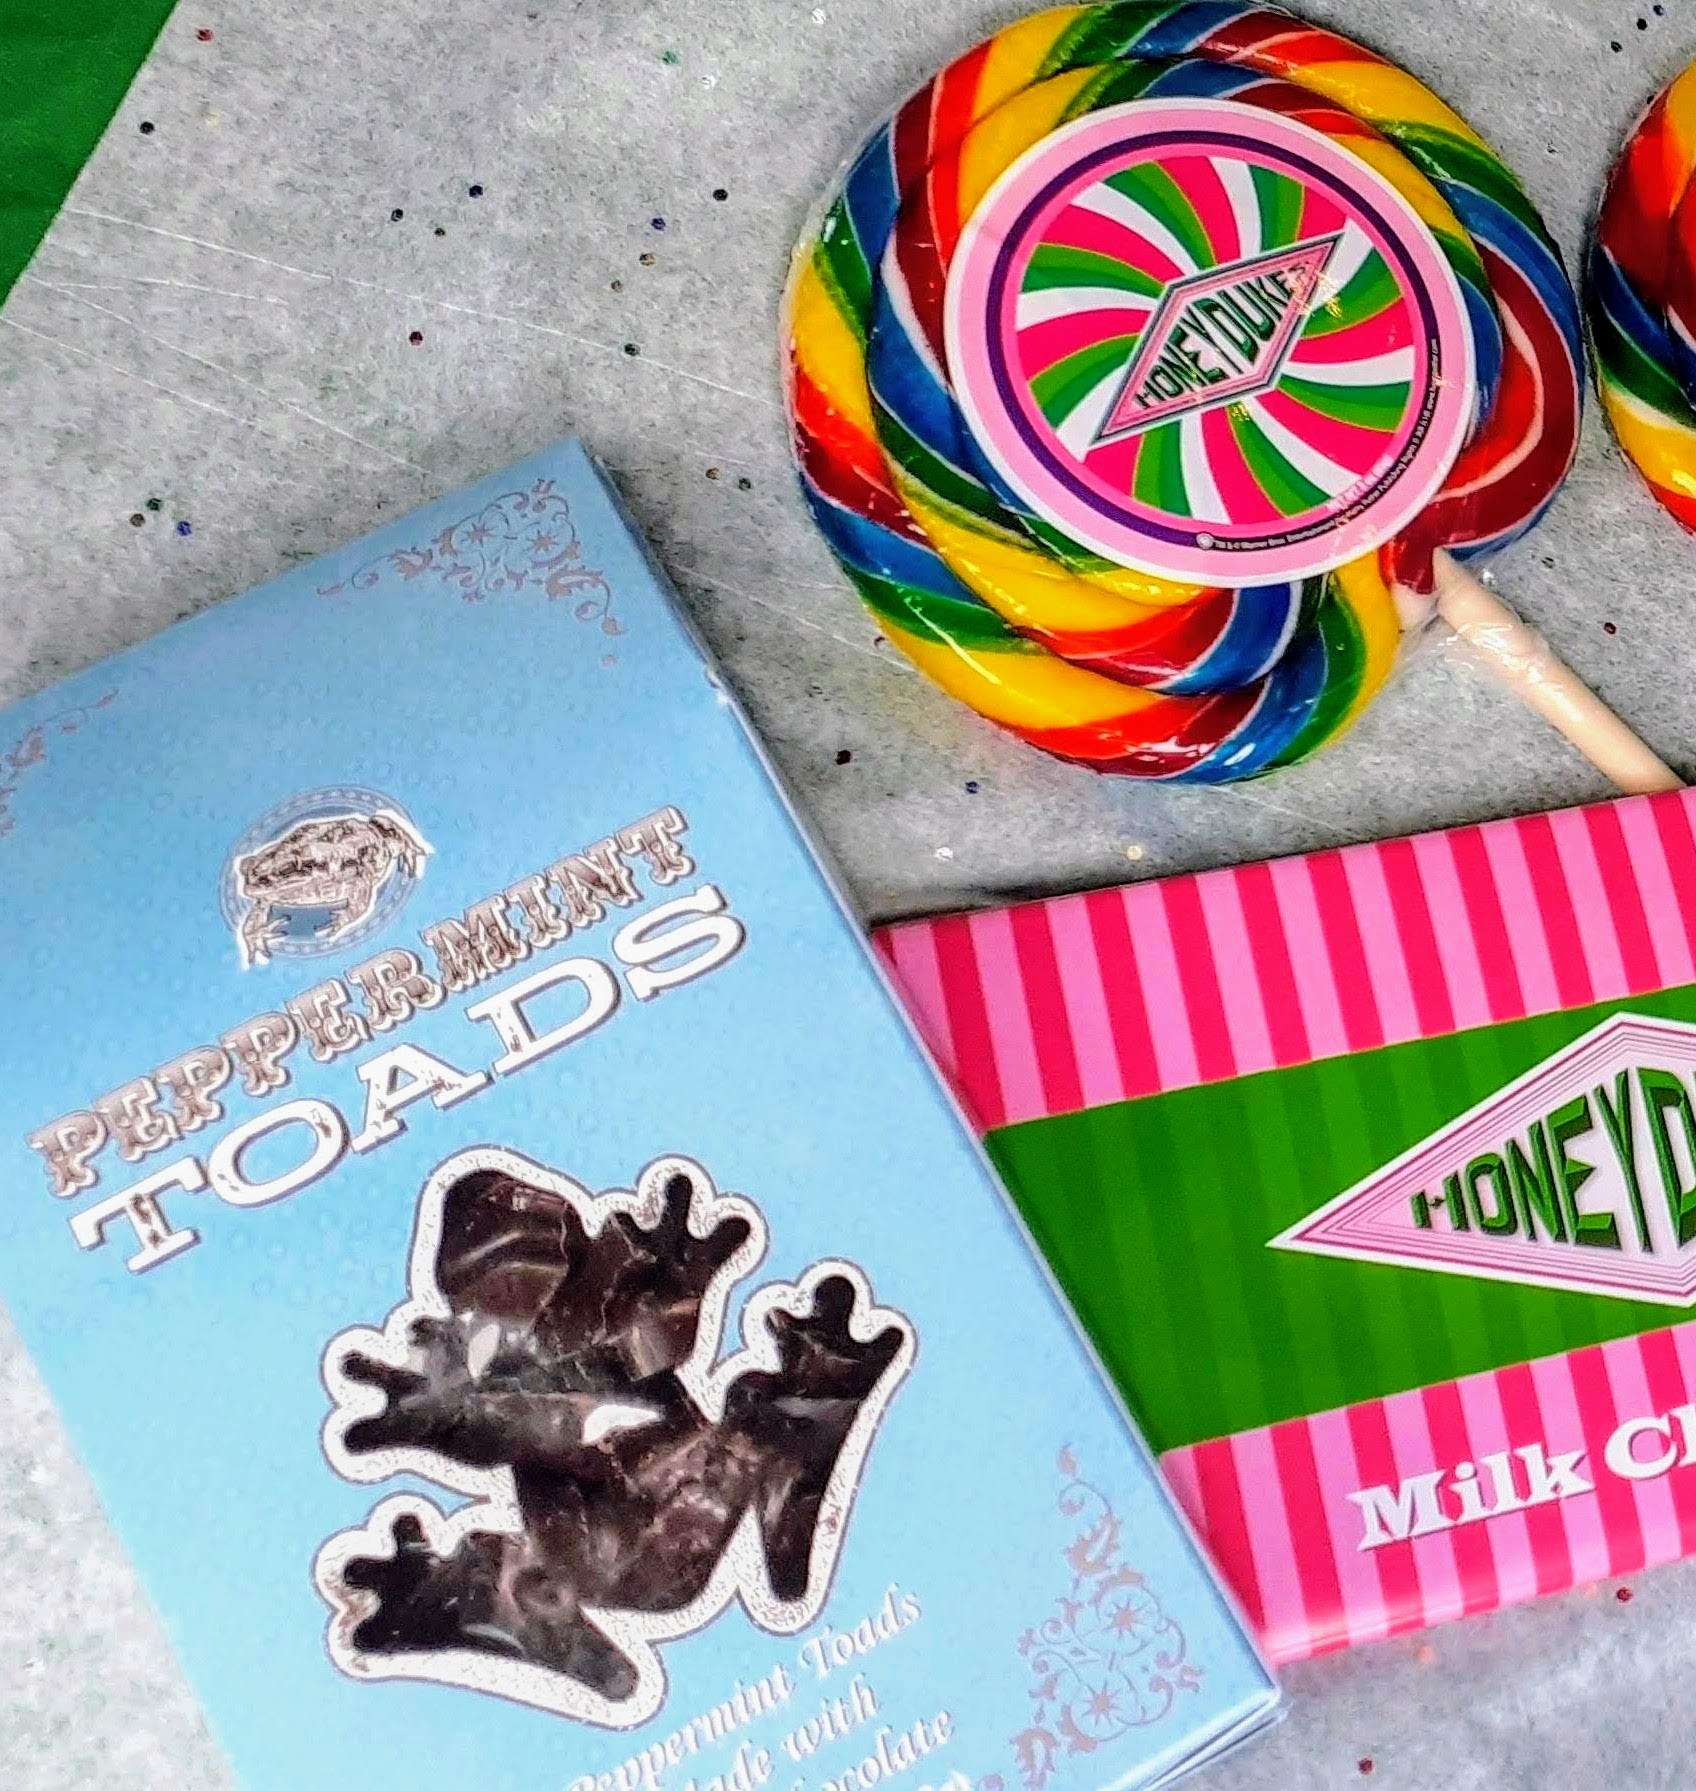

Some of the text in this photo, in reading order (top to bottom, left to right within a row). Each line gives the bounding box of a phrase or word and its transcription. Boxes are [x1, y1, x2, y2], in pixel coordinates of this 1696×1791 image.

[27, 805, 696, 1198] PEPPERMINT
[67, 883, 746, 1275] TOADS
[1346, 1441, 1597, 1551] Milk
[800, 1582, 924, 1680] Toads
[783, 1671, 881, 1762] with
